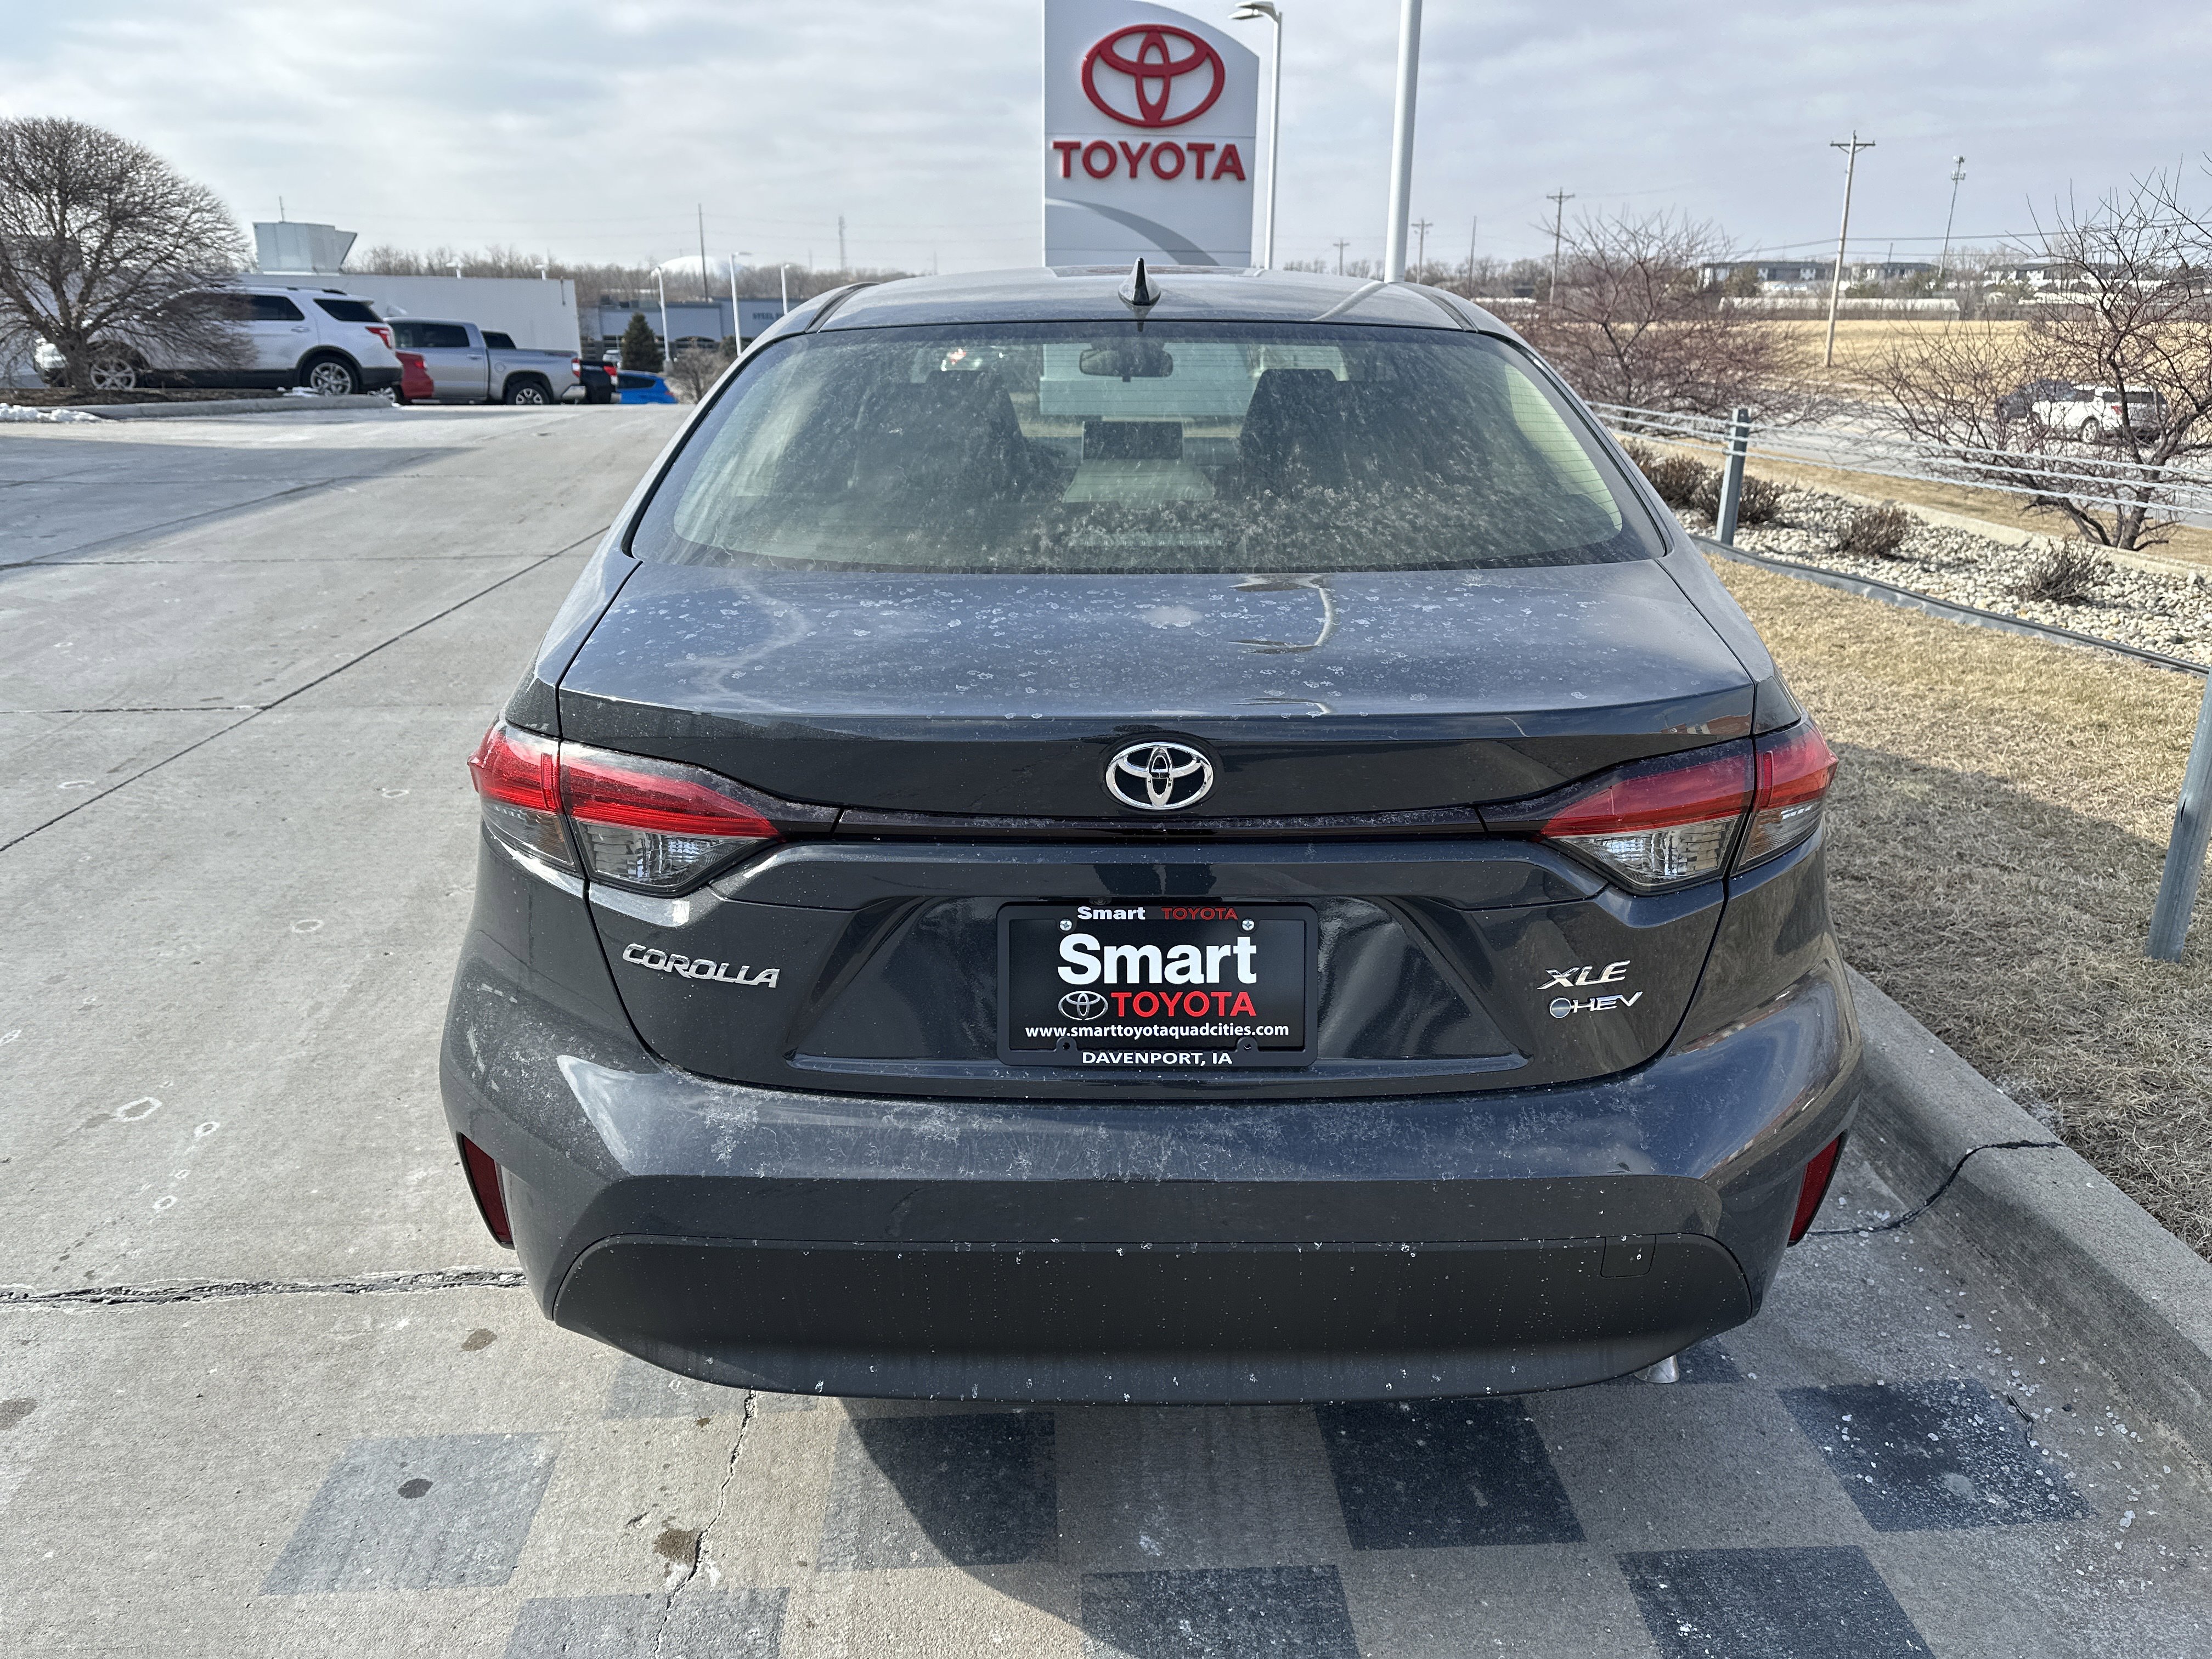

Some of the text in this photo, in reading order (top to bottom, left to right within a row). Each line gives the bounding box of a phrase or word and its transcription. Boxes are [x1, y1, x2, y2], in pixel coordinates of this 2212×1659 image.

[1053, 140, 1246, 180] TOYOTA
[1077, 906, 1238, 920] Smart TOYOTA
[622, 943, 780, 988] COROLLA
[1057, 933, 1257, 985] Smart
[1537, 960, 1630, 990] XLE
[1111, 991, 1257, 1017] TOYOTA
[1573, 991, 1643, 1013] HEV
[1025, 1023, 1289, 1040] www.smarttoyotaquadcities.com
[1082, 1052, 1233, 1066] DAVENPORT, IA
